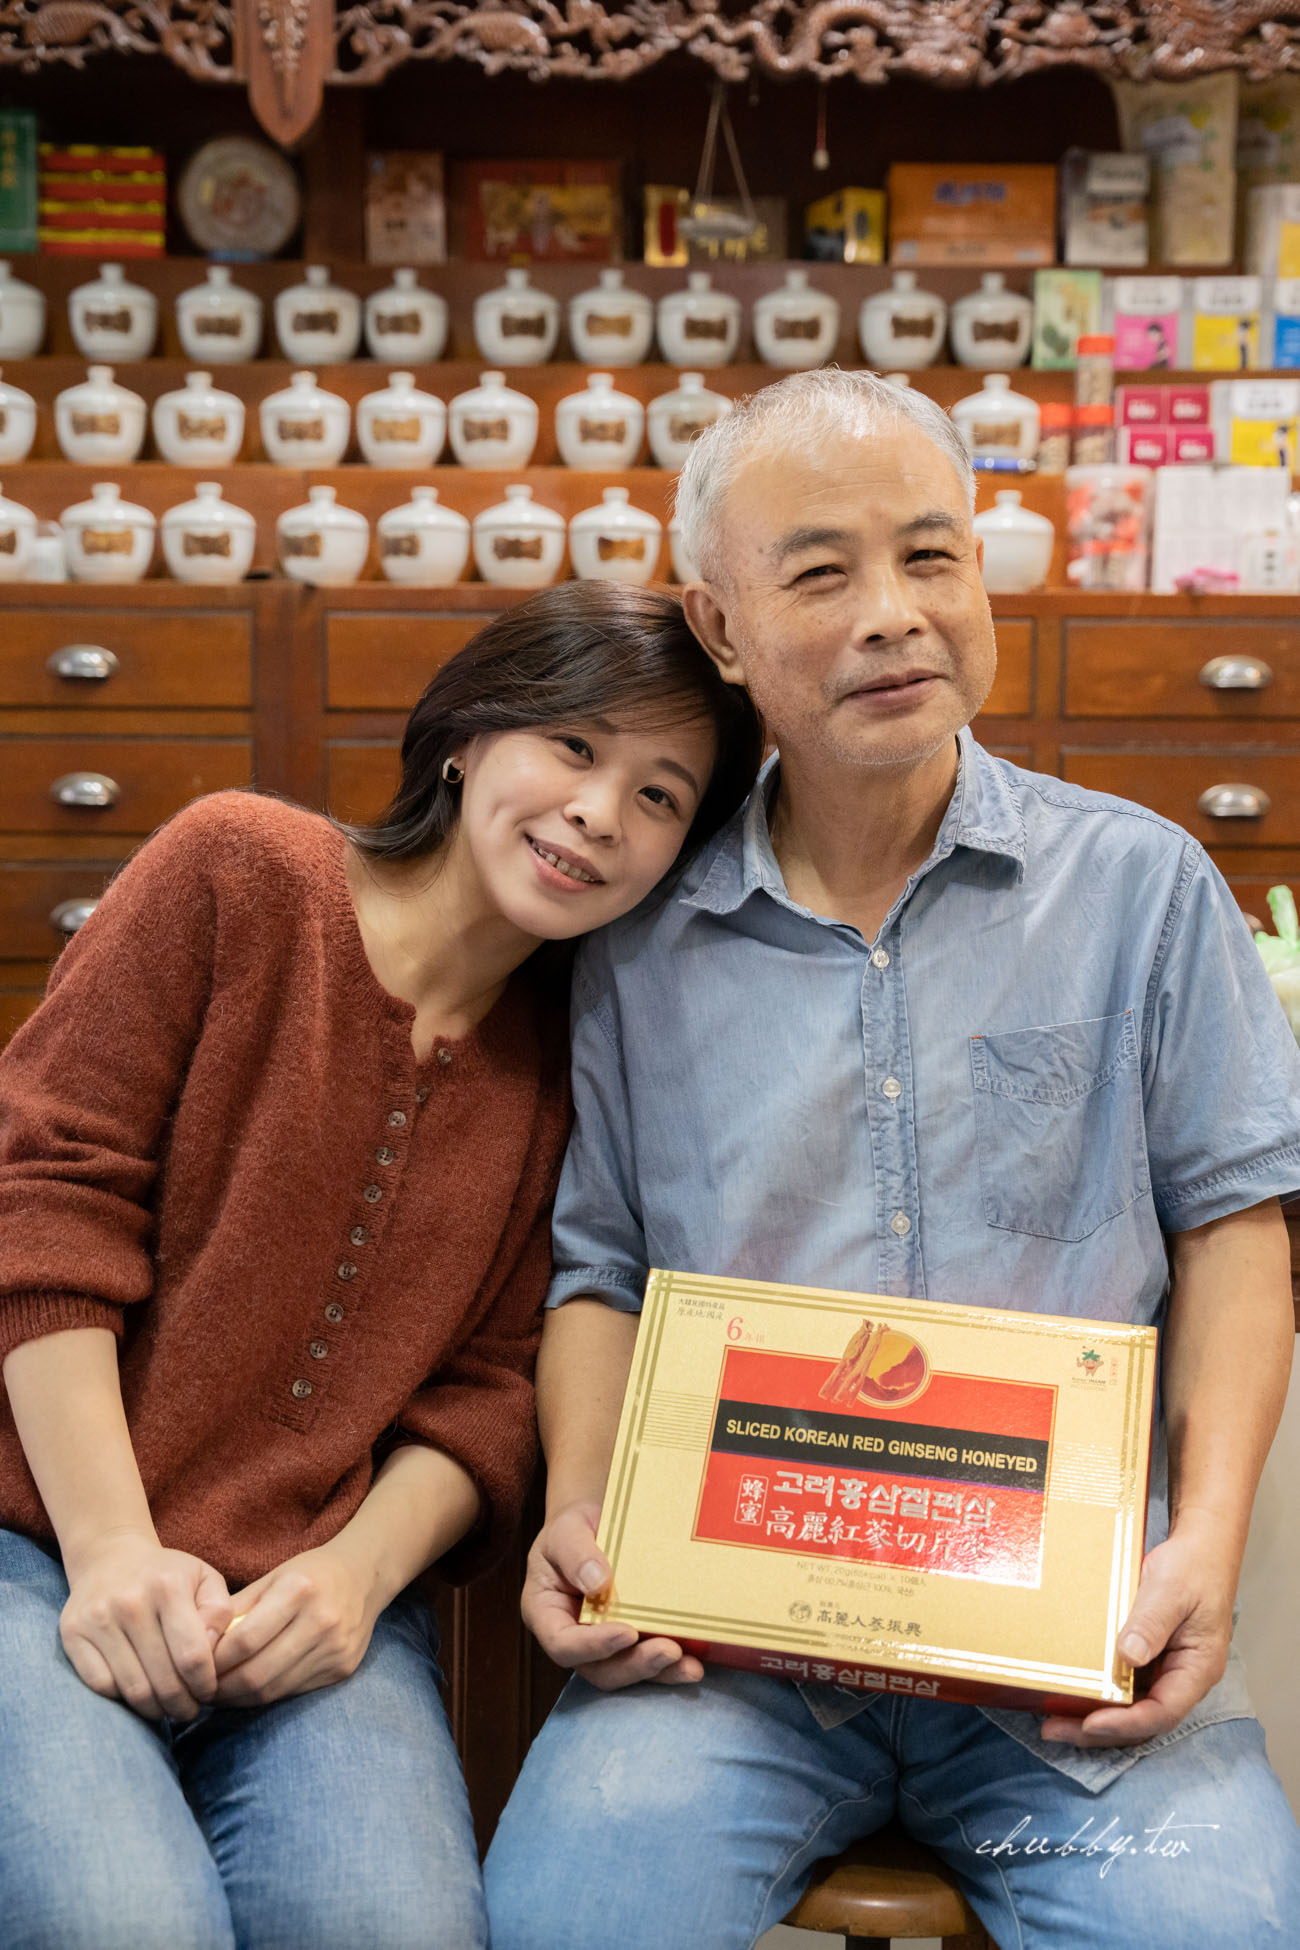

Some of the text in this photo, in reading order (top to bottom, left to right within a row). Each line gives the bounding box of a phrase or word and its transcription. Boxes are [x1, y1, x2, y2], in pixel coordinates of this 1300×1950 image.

[726, 1419, 1038, 1473] SLICED KOREAN RED GINSENG HONEYED
[773, 1470, 996, 1528] 고려홍삼절편삼
[760, 1656, 941, 1697] 고려홍삼절편삼
